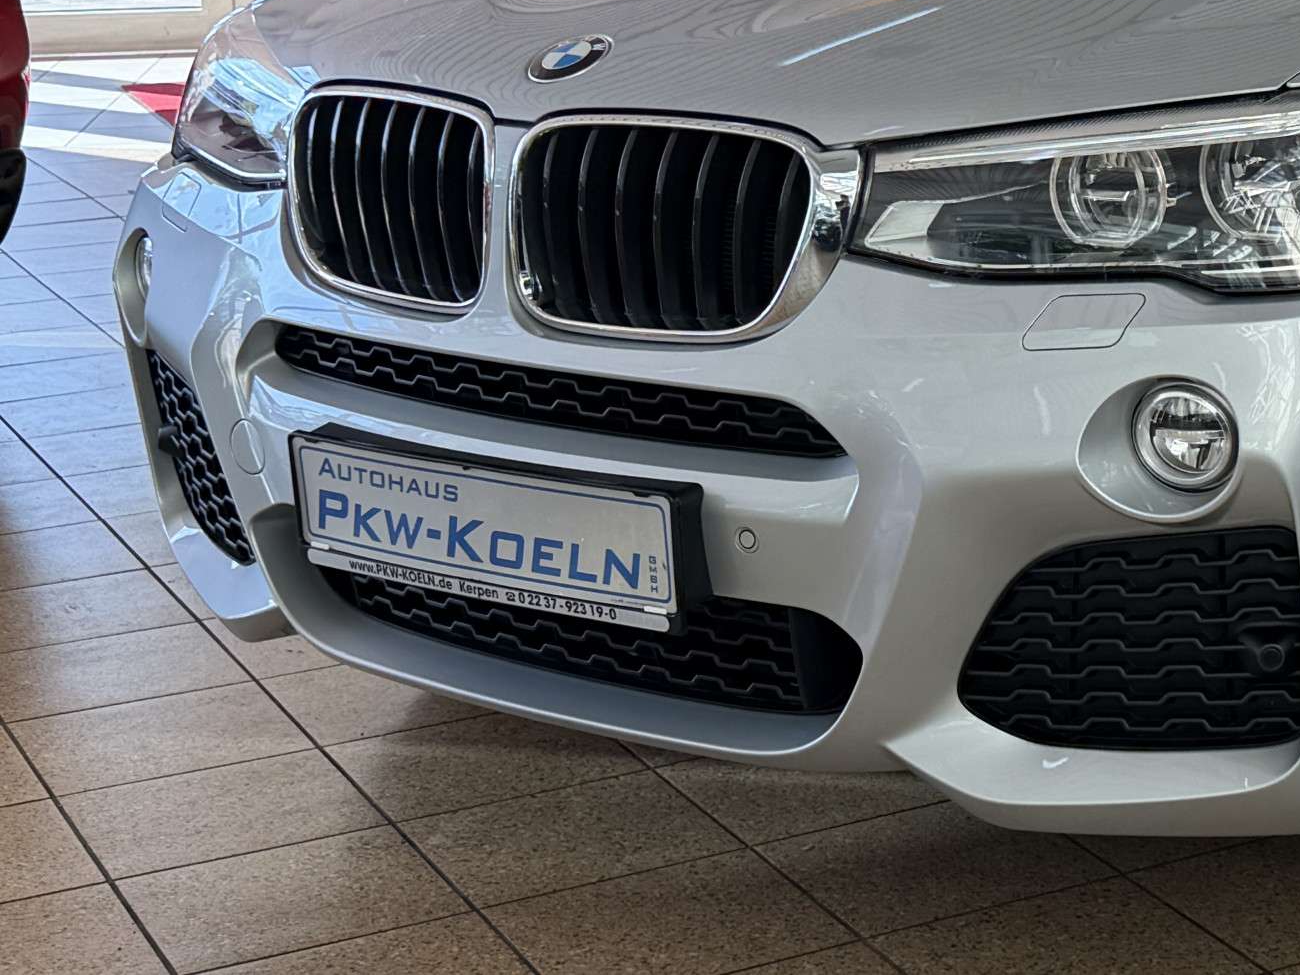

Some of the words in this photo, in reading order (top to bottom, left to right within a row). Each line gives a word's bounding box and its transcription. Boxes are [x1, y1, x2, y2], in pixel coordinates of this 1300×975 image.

[318, 457, 459, 502] AUTOHAUS
[318, 488, 641, 590] PKW-KOELN
[348, 560, 453, 590] www.PKW-KOELN.de
[458, 581, 500, 601] Kerpen
